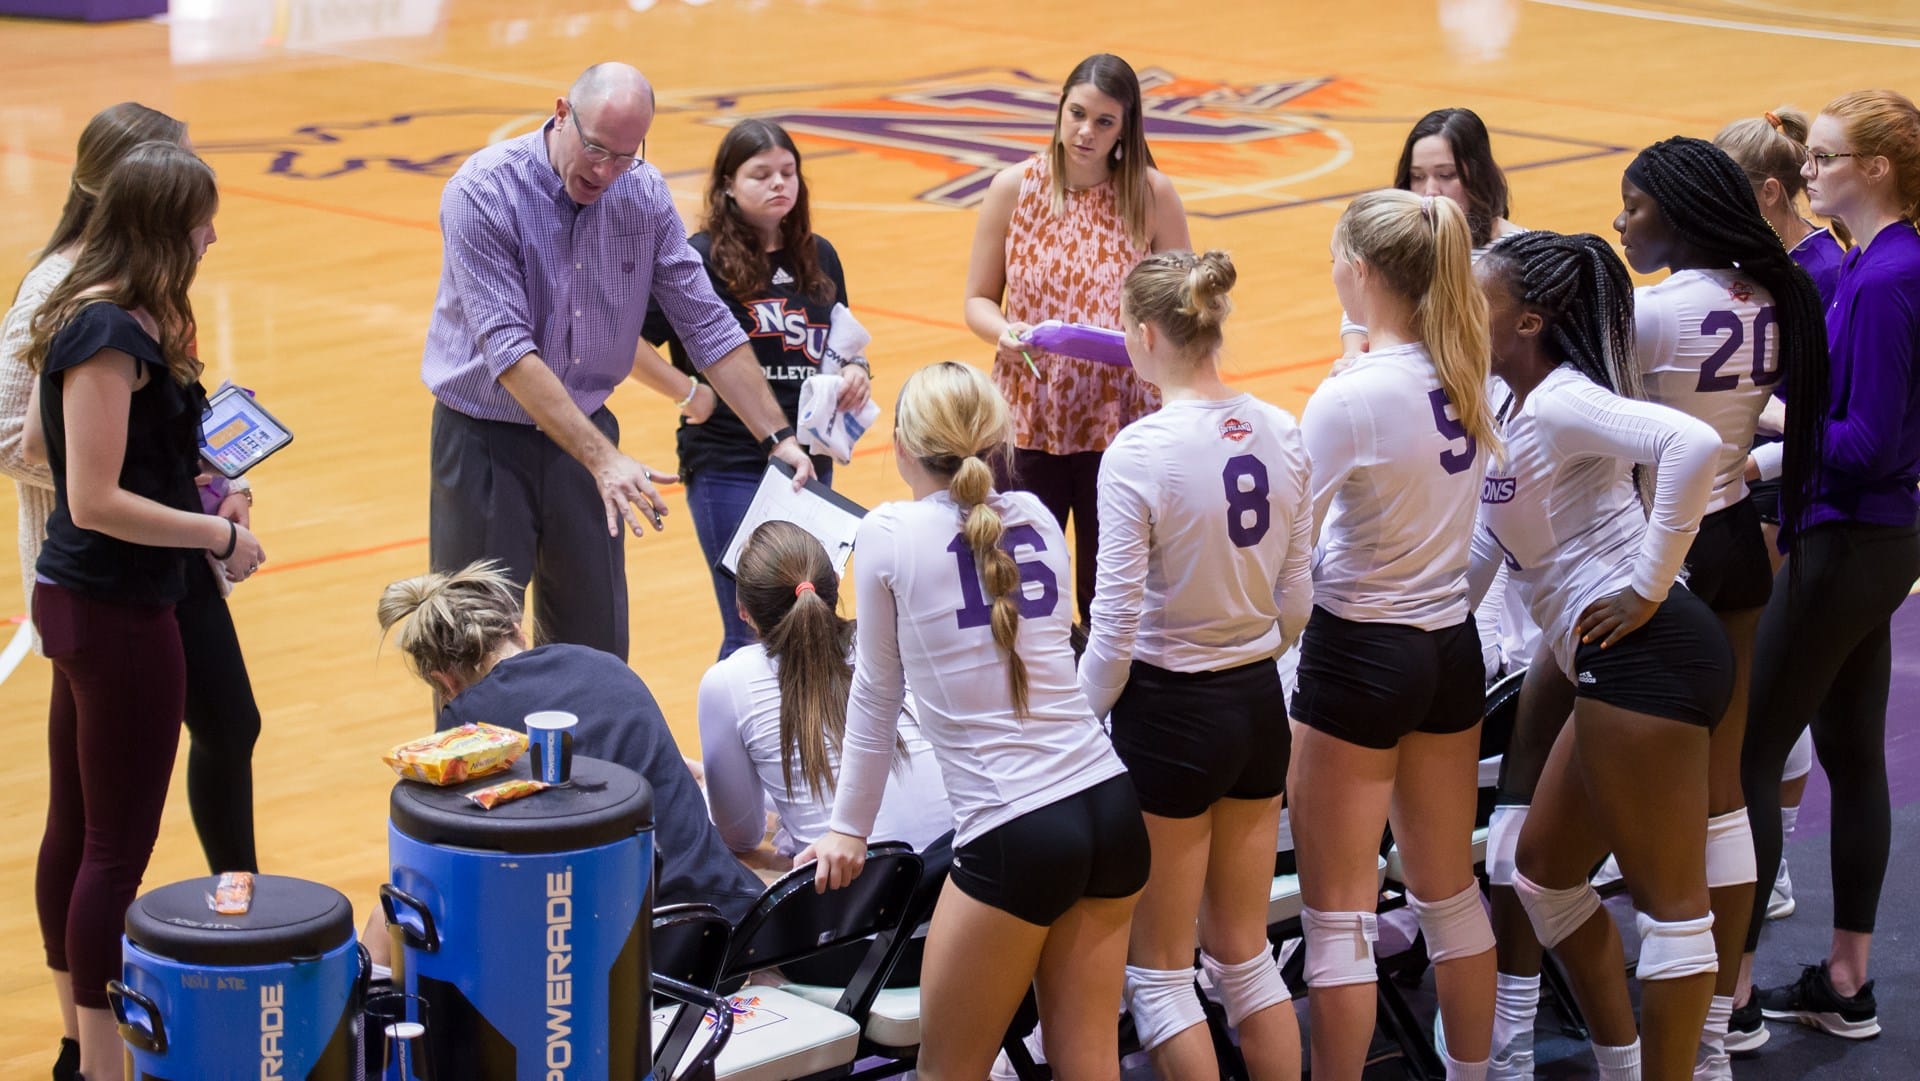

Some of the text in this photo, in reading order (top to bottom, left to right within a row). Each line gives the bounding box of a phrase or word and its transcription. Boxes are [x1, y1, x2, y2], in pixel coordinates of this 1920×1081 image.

[753, 301, 829, 360] NSU
[1695, 306, 1783, 392] 20
[1428, 388, 1476, 475] 5
[1222, 454, 1270, 548] 8
[946, 524, 1058, 629] 16
